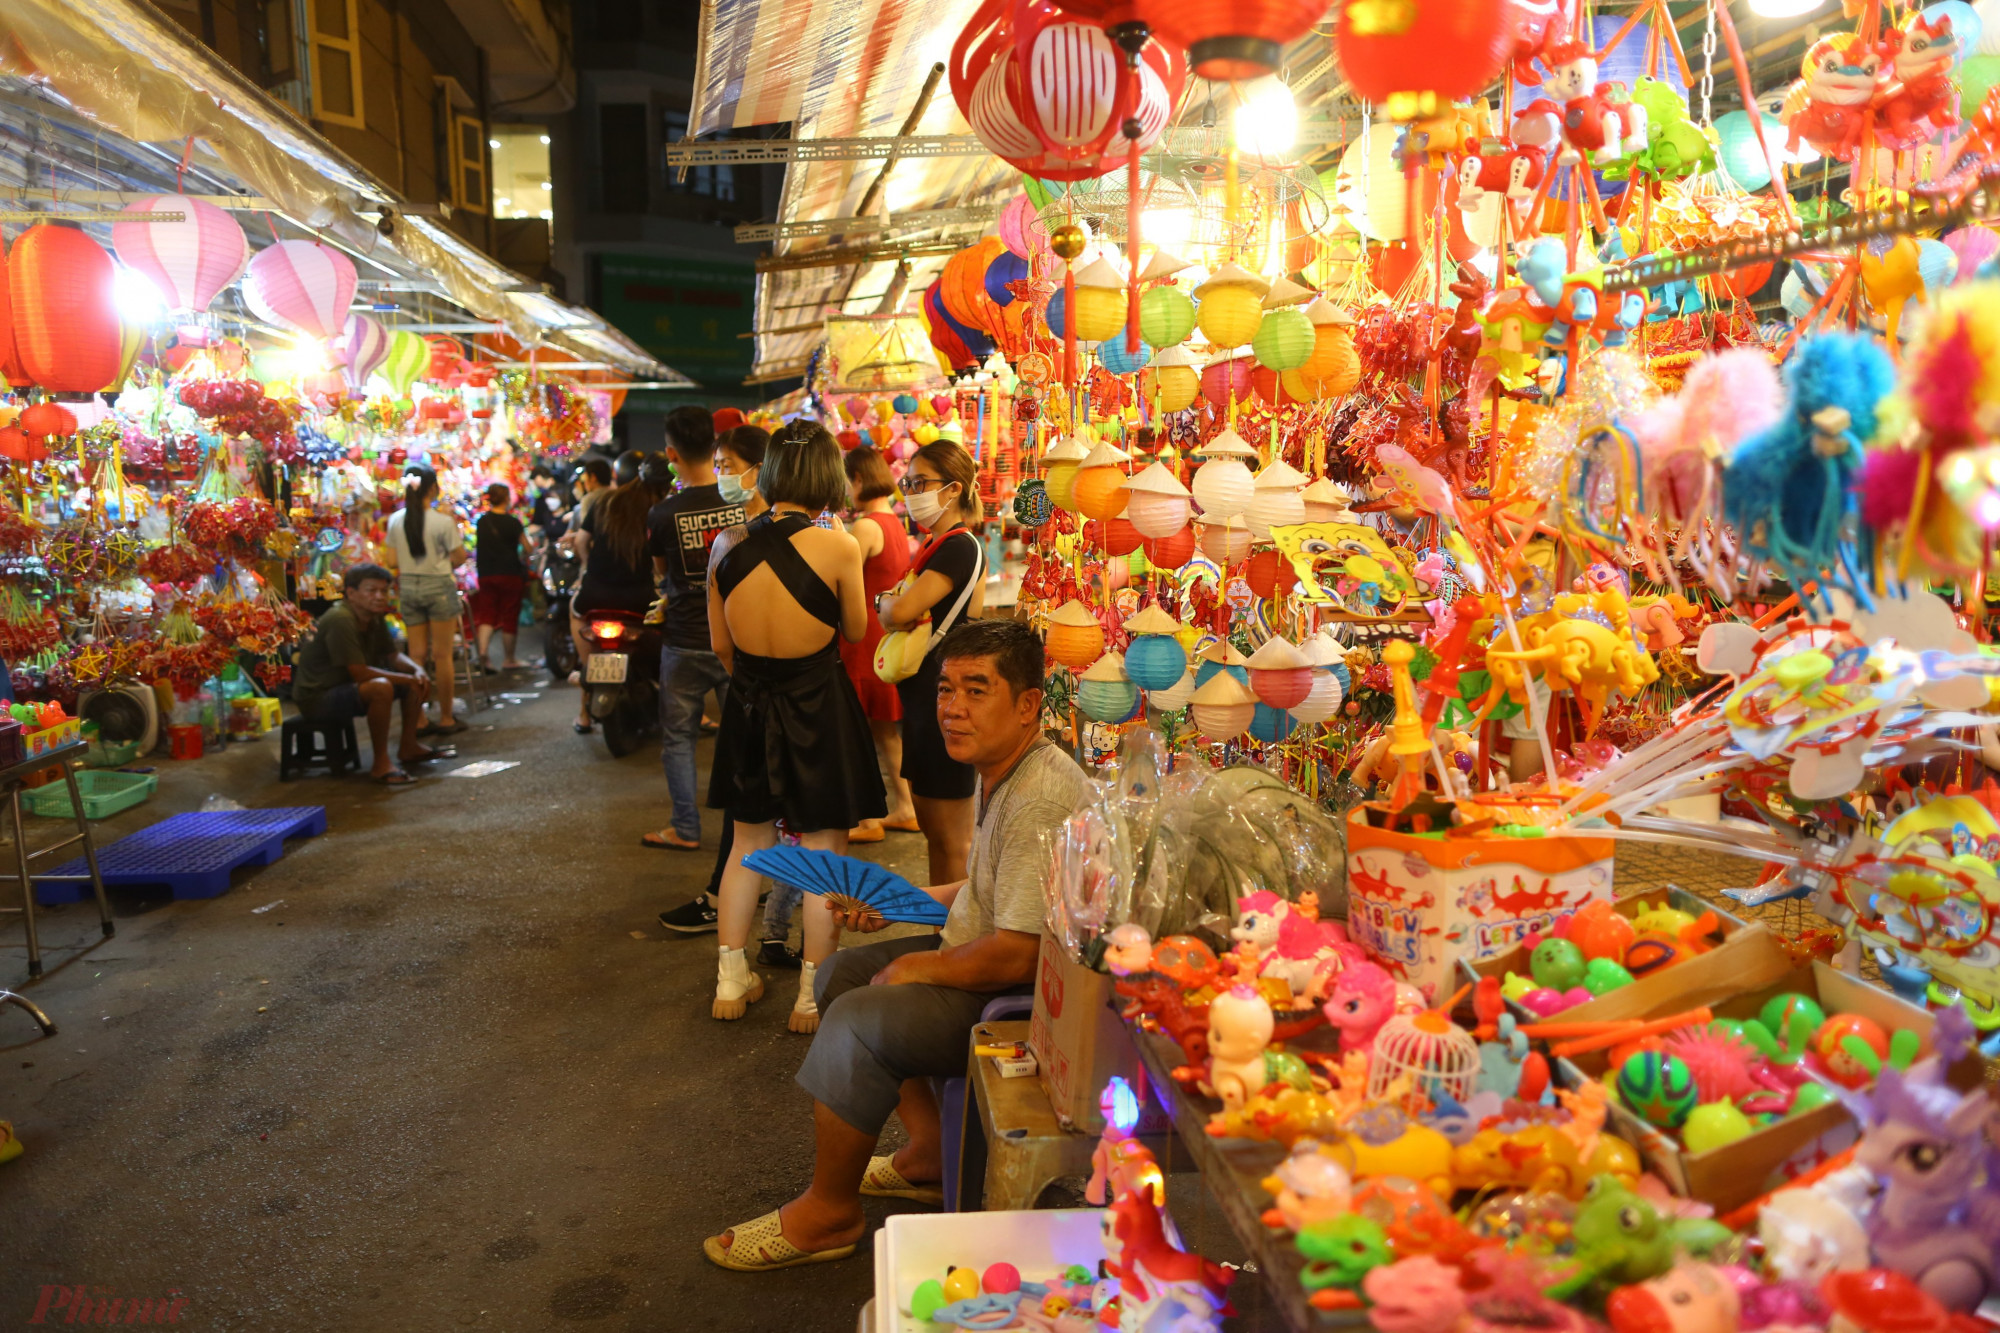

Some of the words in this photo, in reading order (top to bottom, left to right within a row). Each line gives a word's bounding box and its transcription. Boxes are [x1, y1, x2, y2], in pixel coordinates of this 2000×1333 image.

[678, 507, 746, 533] SUCCESS
[1373, 907, 1418, 933] BLOW
[1480, 921, 1525, 947] LET'S
